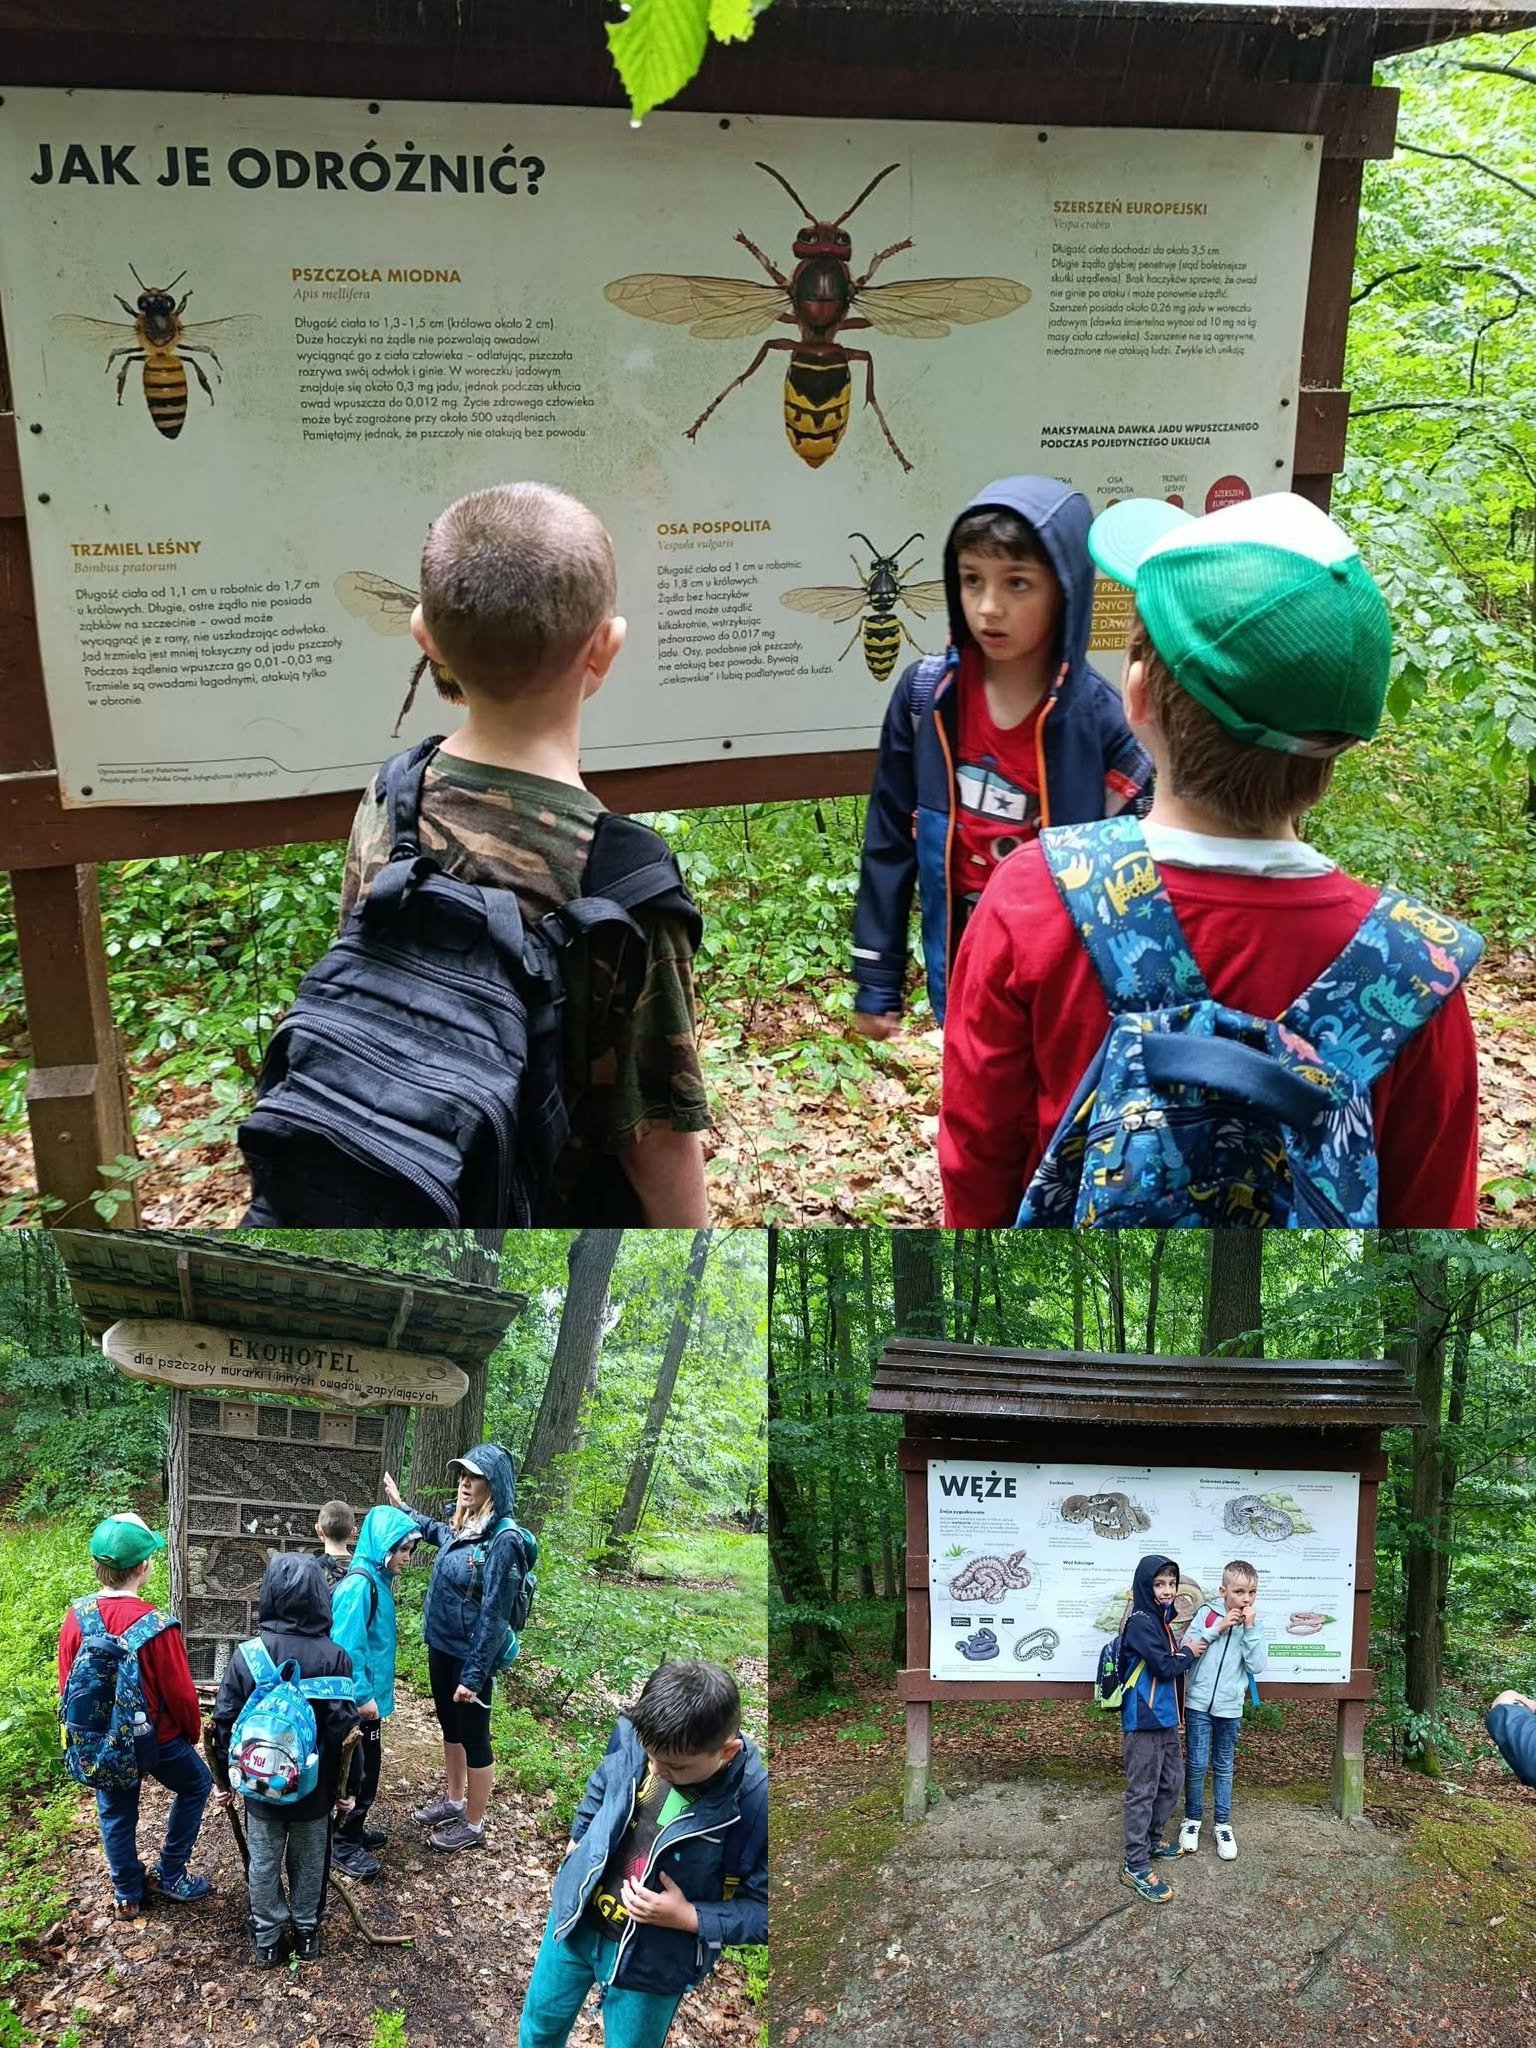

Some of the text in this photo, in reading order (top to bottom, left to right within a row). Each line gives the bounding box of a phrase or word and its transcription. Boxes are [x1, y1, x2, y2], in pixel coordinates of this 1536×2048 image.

[30, 139, 546, 196] JAK JE ODRÓŻNIĆ?
[1053, 198, 1208, 215] SZERSZEŃ EUROPEJSKI
[292, 268, 462, 283] PSZCZOŁA MIODNA
[293, 287, 371, 302] Apis mellifera
[295, 317, 337, 332] Długość
[340, 317, 366, 329] ciała
[369, 318, 379, 329] to
[429, 321, 444, 329] cm
[447, 317, 491, 332] (królowa
[494, 317, 522, 329] około
[526, 318, 532, 329] 2
[296, 333, 323, 344] Duże
[327, 333, 367, 347] haczyki
[371, 336, 383, 344] na
[419, 334, 434, 344] nie
[437, 333, 491, 347] pozwalają
[494, 333, 540, 344] owadowi
[297, 349, 573, 363] wyciągnąć go z ciała człowieka odlatując, pszczoła
[300, 380, 581, 395] znajduje się około 0,3 mg jadu, jednak podczas ukłucia
[301, 396, 330, 408] owad
[334, 400, 385, 411] wpuszcza
[389, 396, 402, 408] do
[405, 397, 438, 409] 0,012
[463, 395, 490, 410] Życie
[493, 396, 543, 410] zdrowego
[546, 395, 594, 407] człowieka
[302, 413, 330, 424] może
[334, 412, 353, 427] być
[414, 415, 436, 426] przy
[440, 411, 468, 423] około
[471, 412, 493, 423] 500
[1041, 422, 1260, 436] MAKSYMALNA DAWKA JADU WPUSZCZANEGO
[1040, 436, 1211, 449] PODCZAS POJEDYNCZEGO UKŁUCIA
[657, 520, 772, 536] OSA POSPOLITA
[71, 538, 202, 557] TRZMIEL LEŚNY
[74, 562, 177, 576] Bombus pratorum
[75, 579, 320, 603] Długość ciała od 1,1 cm u robotnic do 1,7 cm
[77, 607, 84, 615] u
[87, 602, 144, 617] królowych.
[147, 601, 185, 616] Długie,
[189, 601, 214, 612] ostre
[251, 597, 267, 608] nie
[270, 593, 312, 610] posiada
[80, 613, 273, 633] ząbków na szczecinie owad może
[84, 664, 128, 677] Podczas
[180, 662, 234, 675] wpuszcza
[237, 661, 251, 673] go
[85, 666, 327, 692] Trzmiele są owadami łagodnymi, atakują tylko
[229, 1338, 359, 1373] EKOHOTEL
[134, 1352, 153, 1366] dla
[158, 1358, 216, 1376] pszczoły
[221, 1365, 263, 1379] murarki
[276, 1371, 315, 1386] innych
[320, 1377, 362, 1392] owadów
[367, 1385, 439, 1402] zapylających
[939, 1470, 1017, 1503] WĘŻE
[253, 1755, 266, 1768] YO!
